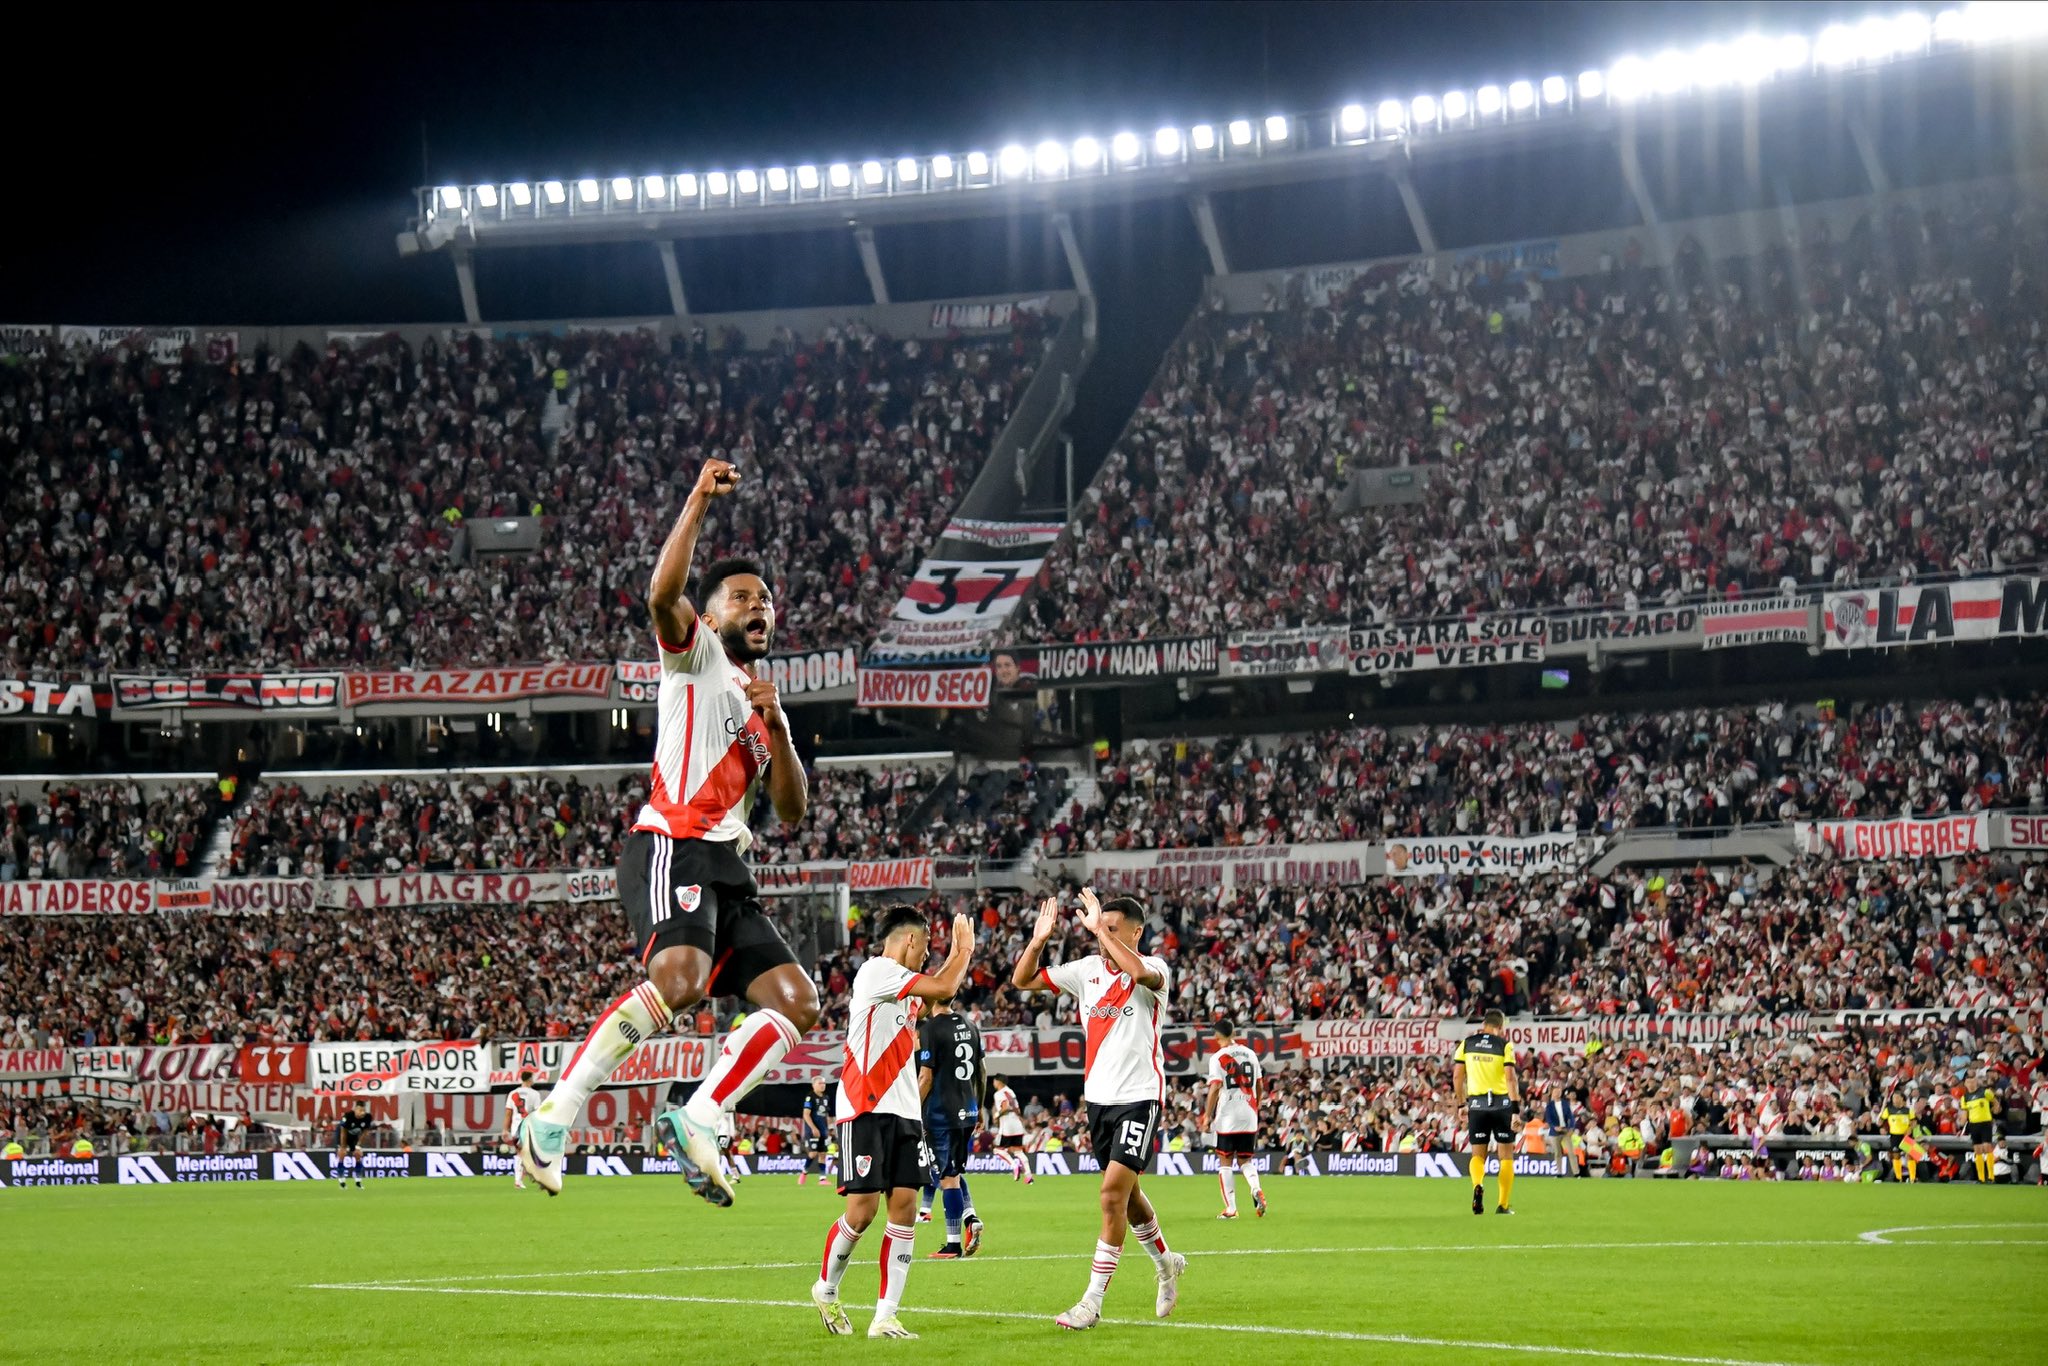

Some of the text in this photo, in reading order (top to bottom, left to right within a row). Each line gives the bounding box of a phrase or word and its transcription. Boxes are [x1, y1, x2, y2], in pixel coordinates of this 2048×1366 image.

[917, 567, 1021, 614] 37
[1551, 609, 1696, 645] BURZACO
[1877, 584, 1953, 643] LA
[1350, 620, 1470, 650] BASTARA
[1480, 618, 1546, 641] SOLO
[1038, 647, 1089, 679] HUGO
[1094, 648, 1106, 674] Y
[1109, 645, 1159, 676] NADA
[1163, 638, 1216, 673] MAS!!!
[1355, 642, 1539, 672] CON VERTE
[117, 677, 336, 706] SOLANO
[347, 664, 607, 699] BERAZATEGUI
[863, 671, 988, 702] ARROYO SECO
[1412, 844, 1460, 866] COLO
[1466, 840, 1486, 868] X
[850, 858, 931, 889] BRAMANTE
[211, 880, 314, 912] NOGUES
[345, 874, 532, 910] ALMAGRO
[1315, 1019, 1443, 1040] LUZURIAGA
[1537, 1026, 1586, 1043] MEJIA
[1589, 1013, 1650, 1042] RIVER
[982, 1031, 1027, 1054] RA
[1308, 1040, 1370, 1056] JUNTOS
[1373, 1039, 1416, 1055] DESDE
[250, 1046, 297, 1077] 77
[317, 1048, 478, 1074] LIBERTADOR
[500, 1046, 559, 1069] FAU
[954, 1043, 974, 1081] 3
[320, 1076, 476, 1092] NICO ENZO
[1119, 1120, 1146, 1147] 15
[12, 1160, 99, 1177] Meridional
[176, 1155, 258, 1172] Meridional
[177, 1172, 259, 1182] SEGUROS
[1328, 1154, 1398, 1172] Meridional
